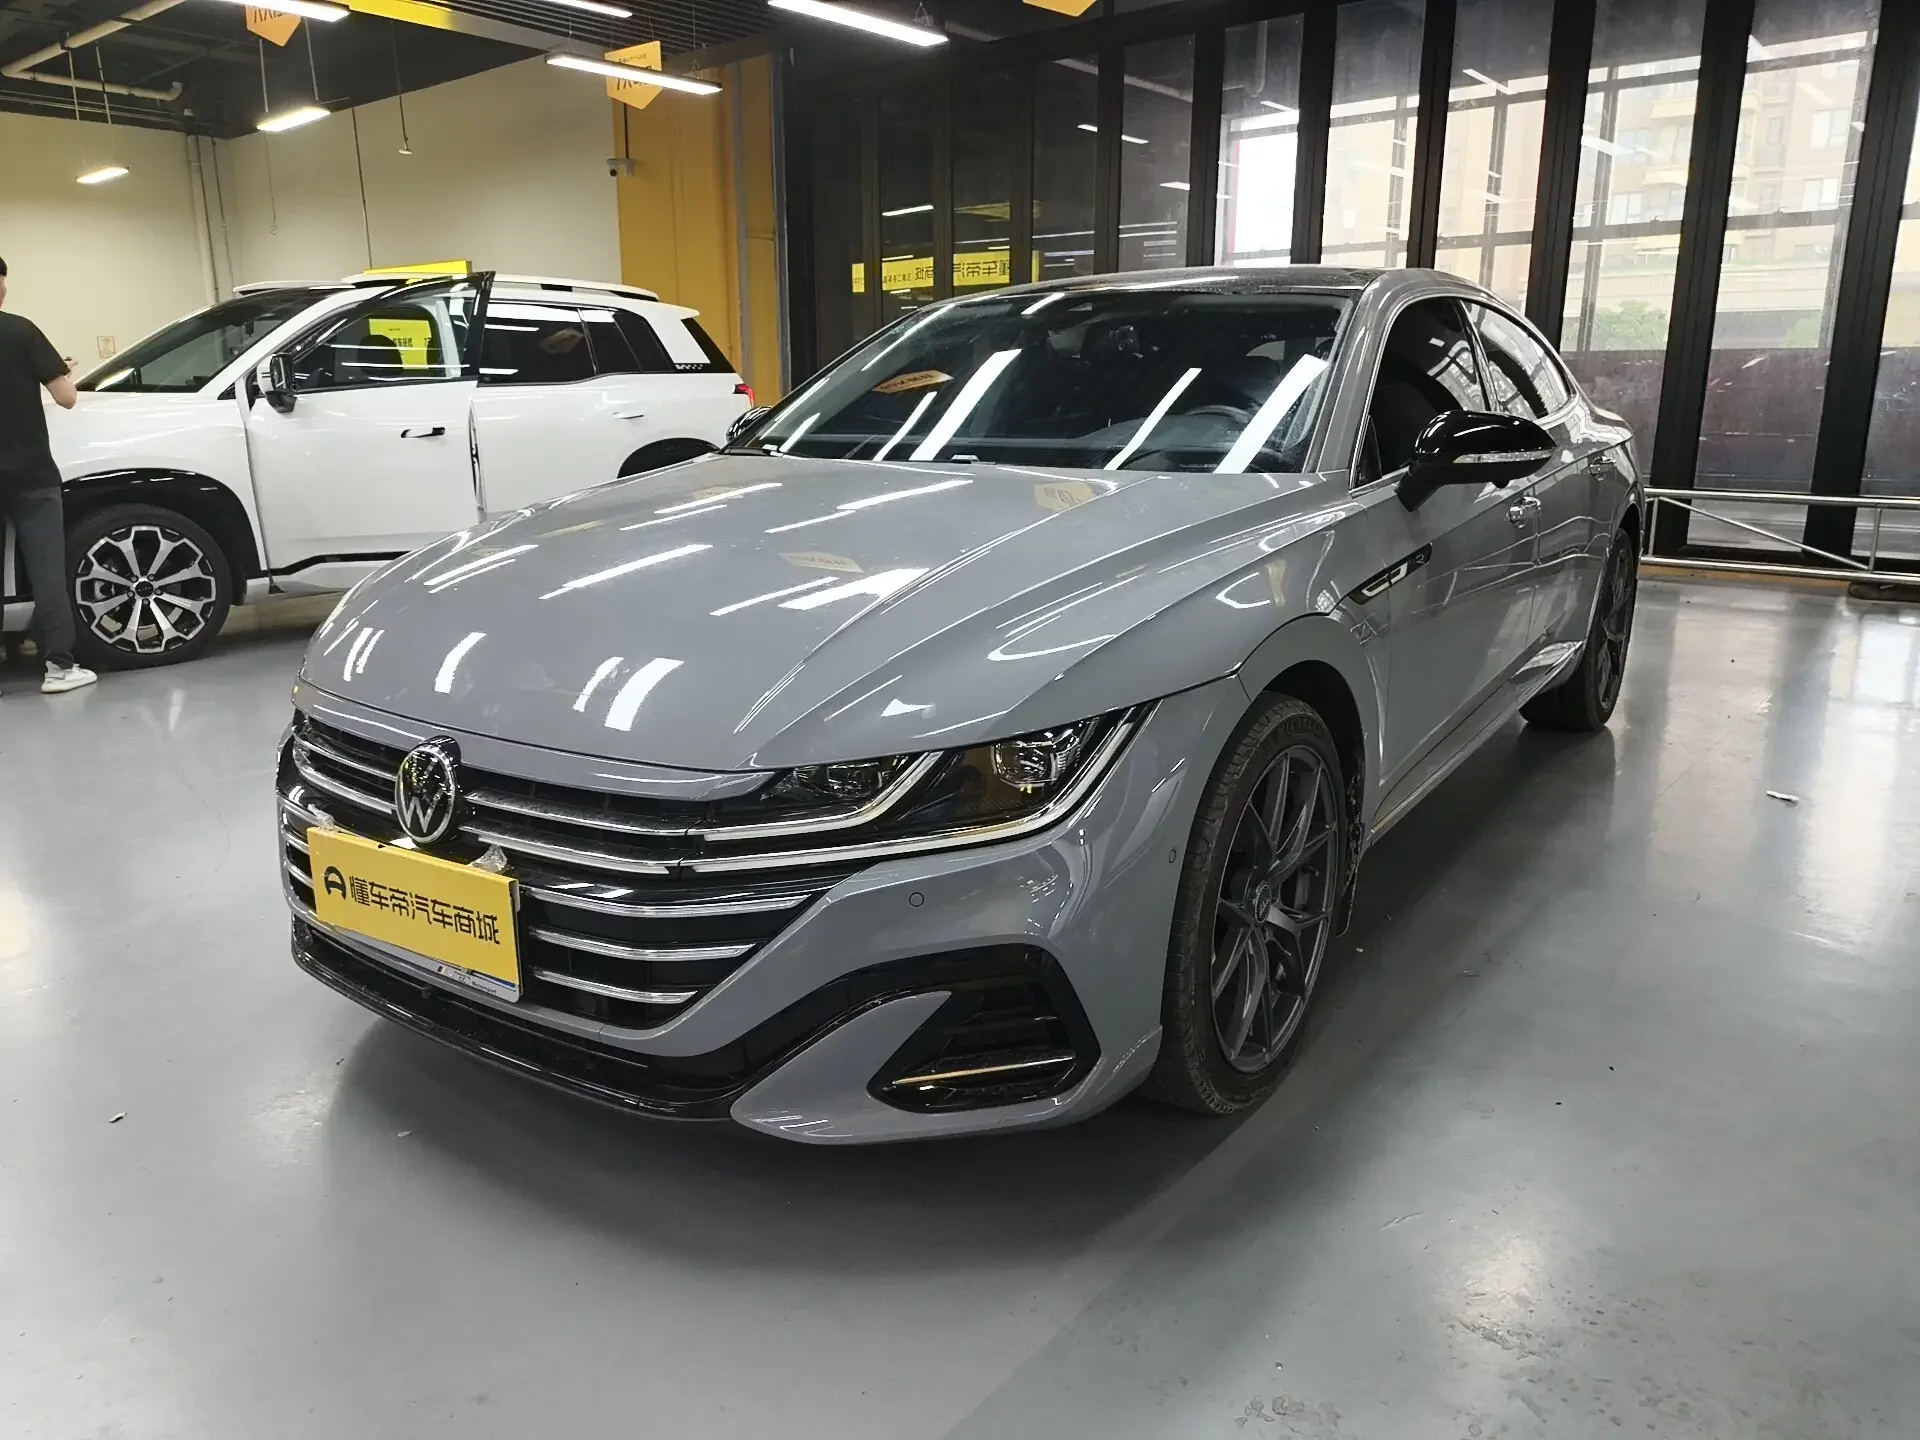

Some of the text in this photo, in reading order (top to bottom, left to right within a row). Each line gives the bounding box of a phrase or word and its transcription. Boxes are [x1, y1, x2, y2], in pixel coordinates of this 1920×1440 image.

[348, 875, 501, 945] 懂车帝汽车商城
